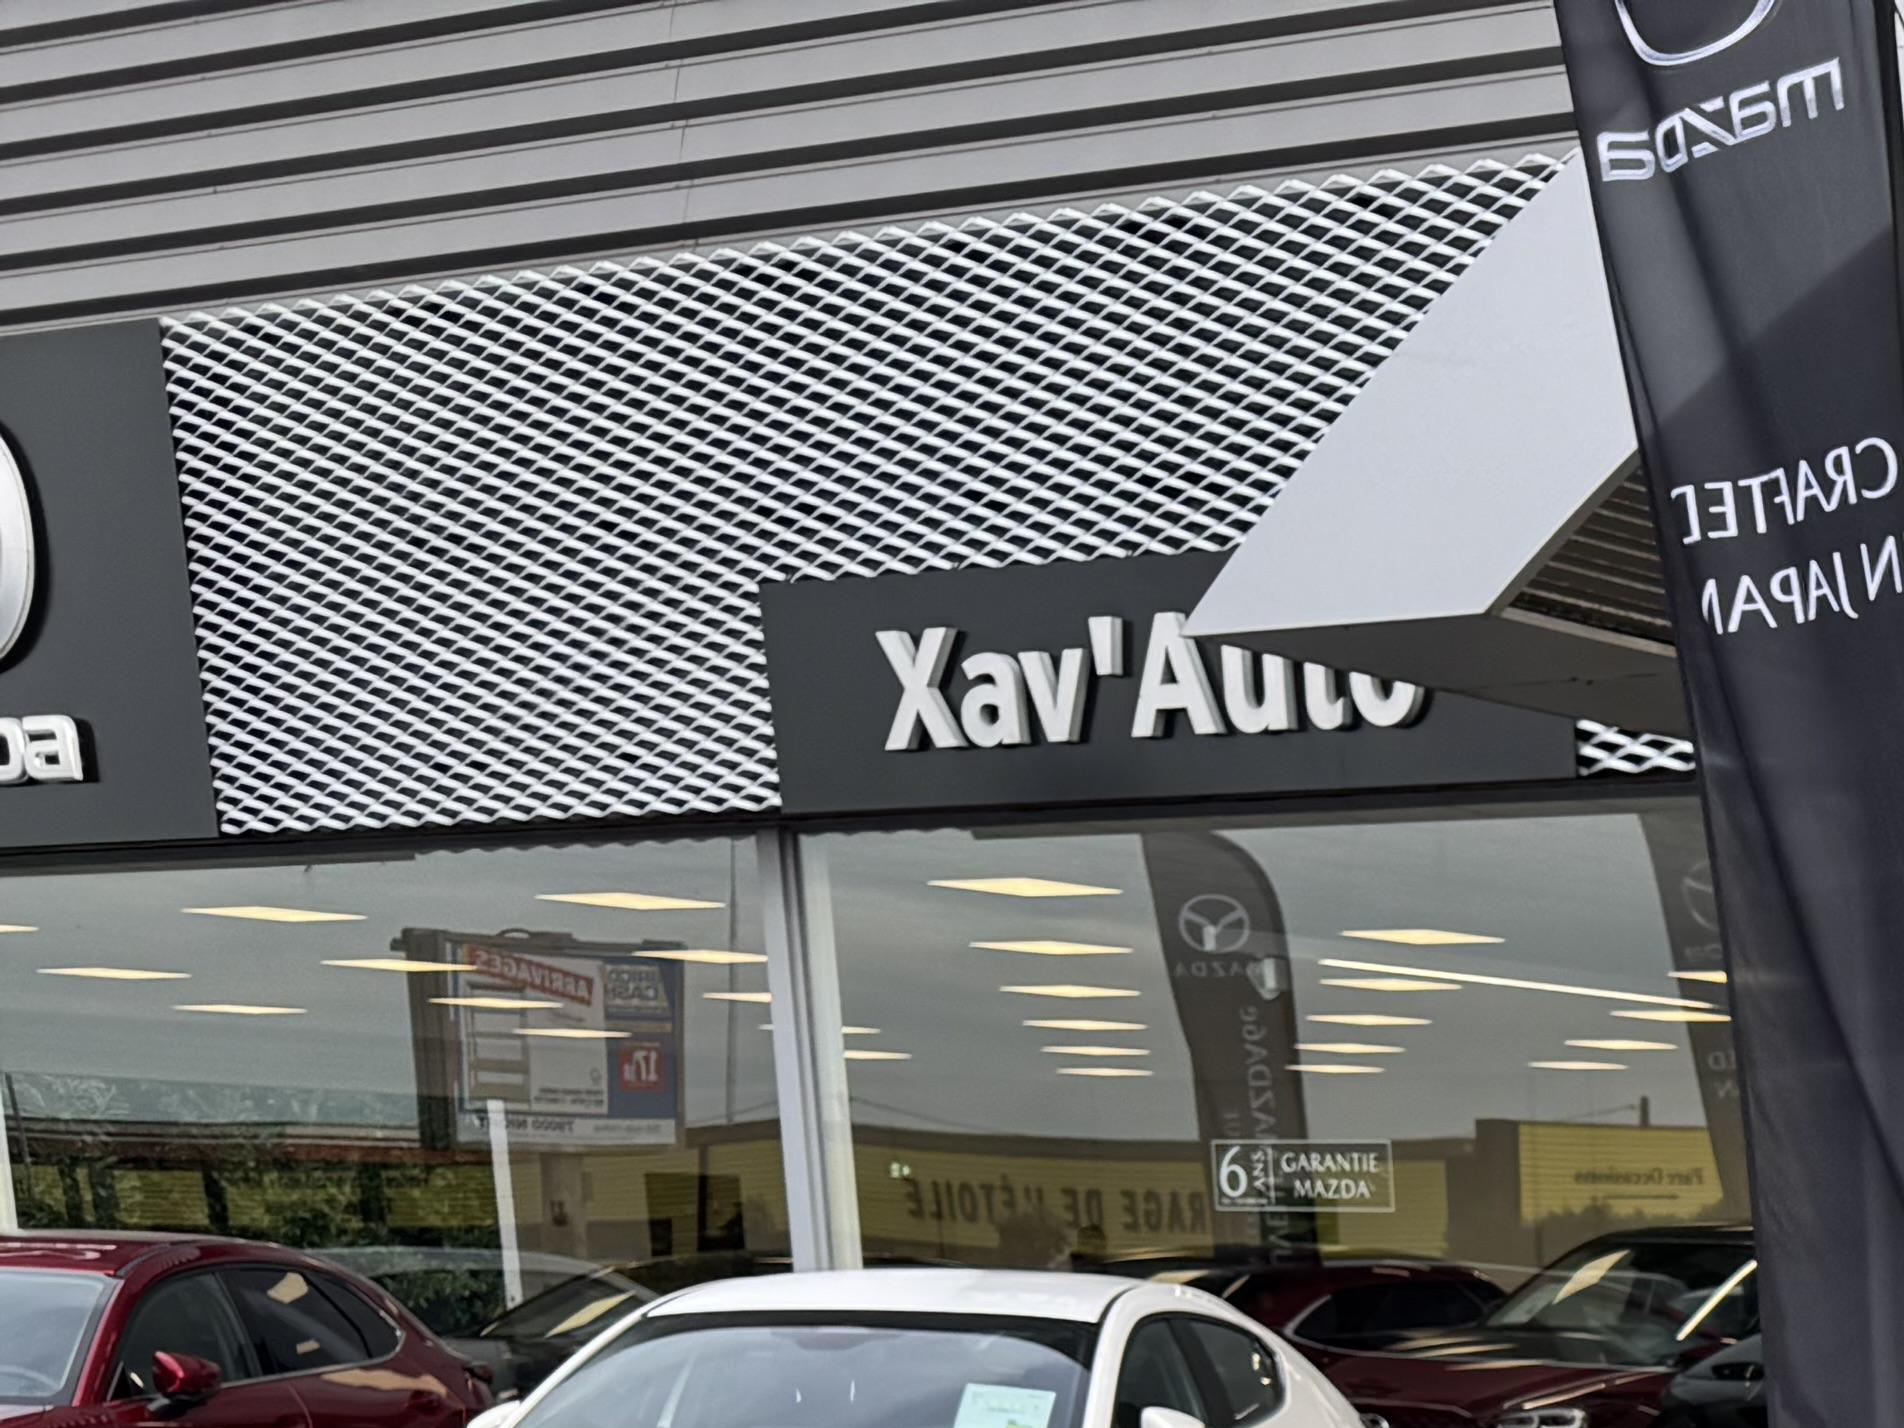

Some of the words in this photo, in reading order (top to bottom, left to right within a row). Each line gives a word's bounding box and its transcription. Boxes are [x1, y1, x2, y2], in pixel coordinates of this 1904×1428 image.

[875, 611, 1424, 752] Xav'Auto
[1219, 1145, 1248, 1198] 6
[1279, 1151, 1381, 1174] GARANTIE
[1293, 1178, 1372, 1200] MAZDA
